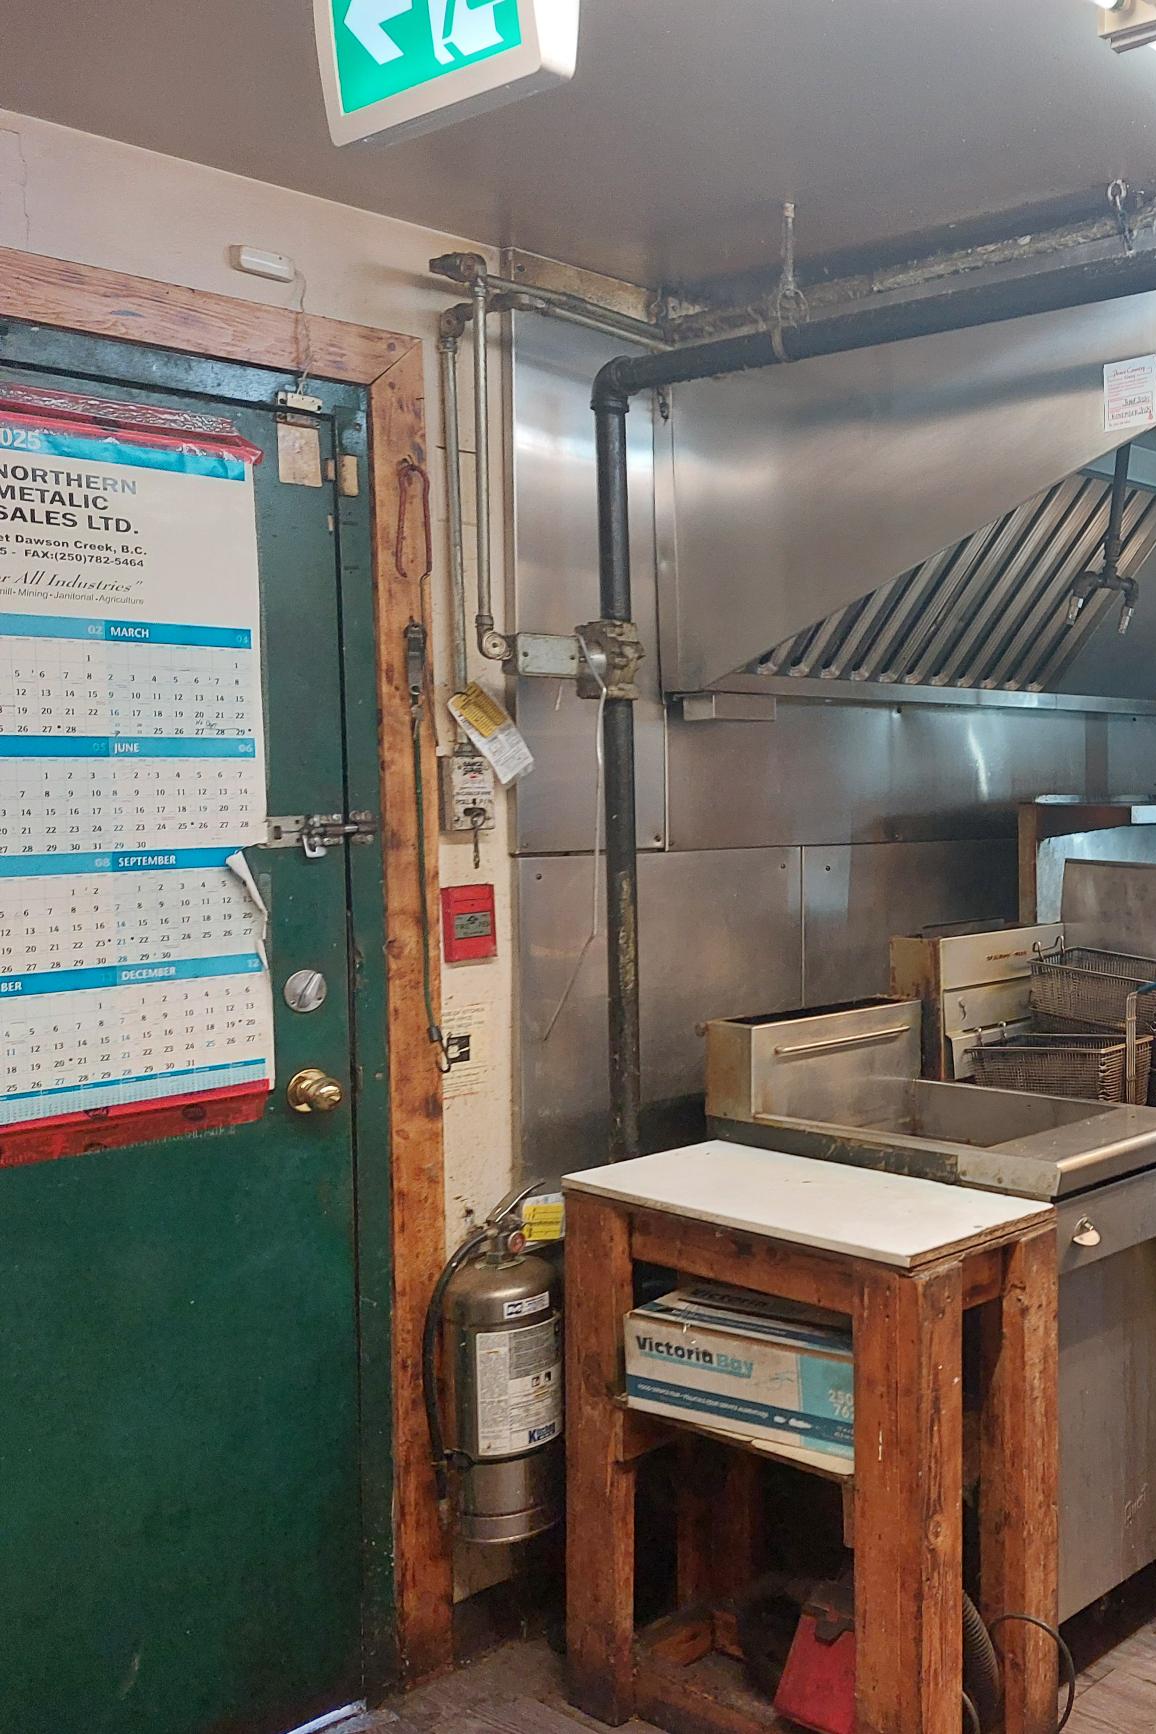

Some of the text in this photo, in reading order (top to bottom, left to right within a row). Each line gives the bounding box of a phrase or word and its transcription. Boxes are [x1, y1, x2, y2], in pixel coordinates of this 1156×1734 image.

[0, 463, 137, 495] NORTHERN
[0, 484, 109, 511] METALIC
[0, 504, 139, 534] SALES LTD.
[15, 534, 69, 548] Dawson
[73, 540, 117, 554] Creek,
[121, 545, 147, 556] B.C.
[24, 549, 144, 567] FAX:(250)782-5464
[14, 570, 46, 584] All
[110, 626, 150, 638] MARCH
[39, 670, 45, 678] 6
[16, 688, 27, 696] 12
[41, 688, 52, 697] 13
[88, 690, 98, 698] 15
[131, 692, 141, 700] 10
[153, 692, 161, 700] 11
[174, 693, 183, 701] 12
[195, 694, 204, 702] 13
[17, 706, 98, 716] 19 20 21 22
[132, 709, 245, 720] 17 18 19 20 21 22
[17, 725, 77, 734] 26 27 28
[153, 727, 246, 736] 25 26 27 28 29
[114, 742, 140, 754] JUNE
[44, 789, 102, 798] 8 10
[198, 788, 207, 796] 12
[21, 807, 102, 817] 14 15 16 17
[135, 806, 145, 814] 16
[156, 806, 166, 814] 17
[218, 804, 229, 812] 20
[21, 824, 102, 835] 21 22 23 24
[156, 823, 167, 831] 24
[22, 842, 102, 853] 28 29 30 31
[136, 841, 147, 849] 30
[118, 855, 176, 867] SEPTEMBER
[222, 896, 232, 904] 12
[23, 909, 29, 917] 6
[138, 919, 148, 927] 15
[160, 917, 170, 925] 16
[181, 915, 191, 924] 17
[1, 922, 105, 937] 12 13 14 15 16
[138, 936, 149, 944] 22
[160, 934, 170, 942] 23
[181, 933, 192, 941] 24
[2, 939, 106, 955] 19 20 21 22 23
[139, 951, 172, 961] 29 30
[1, 957, 107, 974] 26 27 28 29 30
[121, 966, 176, 981] DECEMBER
[31, 1045, 41, 1054] 12
[54, 1042, 64, 1051] 13
[78, 1039, 88, 1048] 14
[142, 1048, 153, 1056] 22
[7, 1053, 111, 1075] 18 19 20 21 22
[144, 1065, 154, 1073] 29
[187, 1059, 195, 1067] 31
[6, 1071, 112, 1093] 25 26 28 29
[636, 1335, 713, 1364] Victoria
